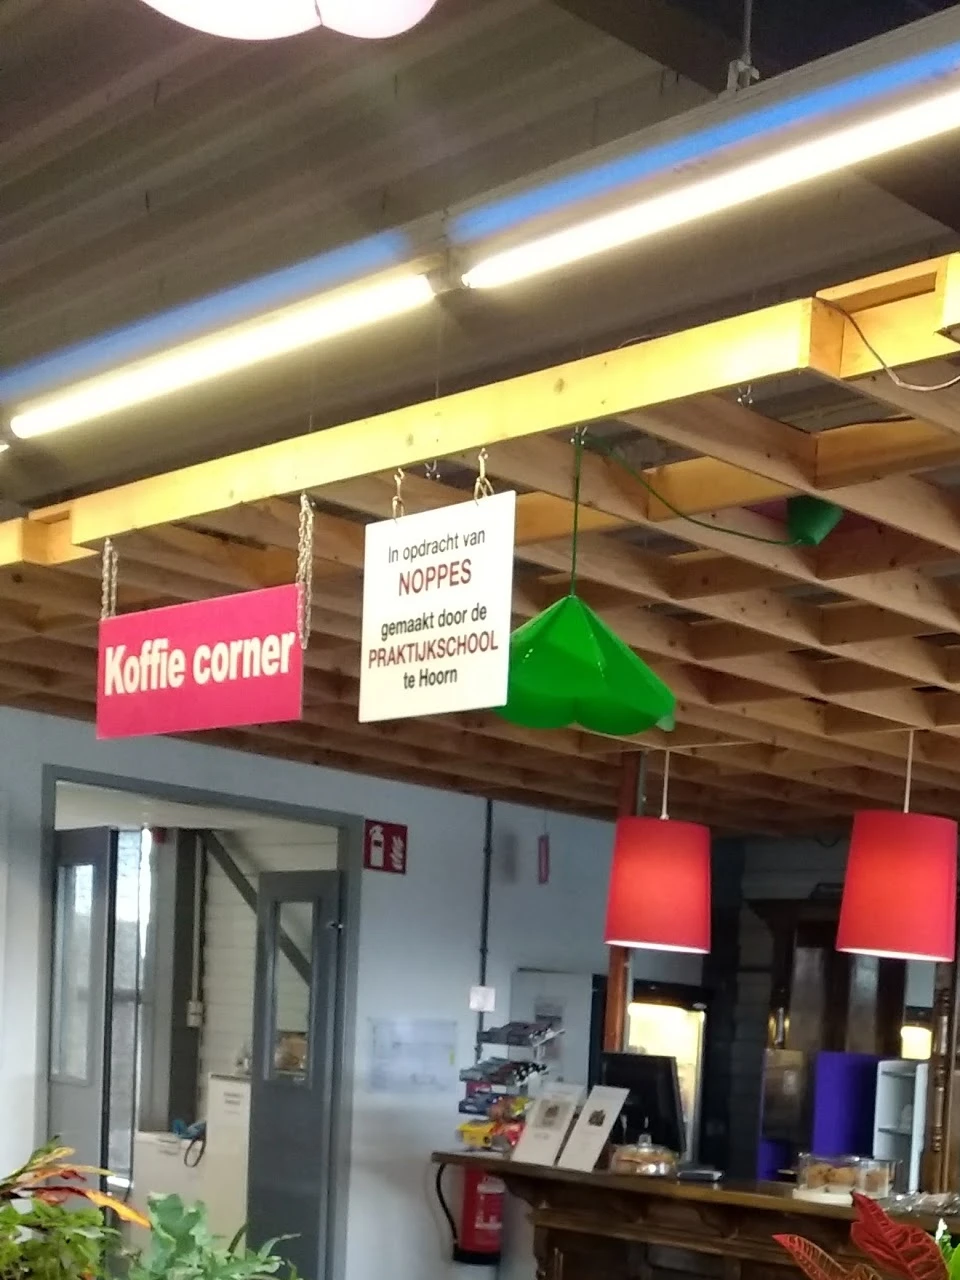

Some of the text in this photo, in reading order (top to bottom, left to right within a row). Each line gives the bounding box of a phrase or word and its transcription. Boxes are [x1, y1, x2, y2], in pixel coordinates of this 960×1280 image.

[388, 530, 485, 563] In opdracht van
[399, 558, 472, 596] NOPPES
[381, 602, 487, 642] gemaakt door de
[104, 631, 296, 696] Koffie corner
[368, 630, 499, 669] PRAKTIJKSCHOOL
[403, 667, 458, 690] te Hoorn
